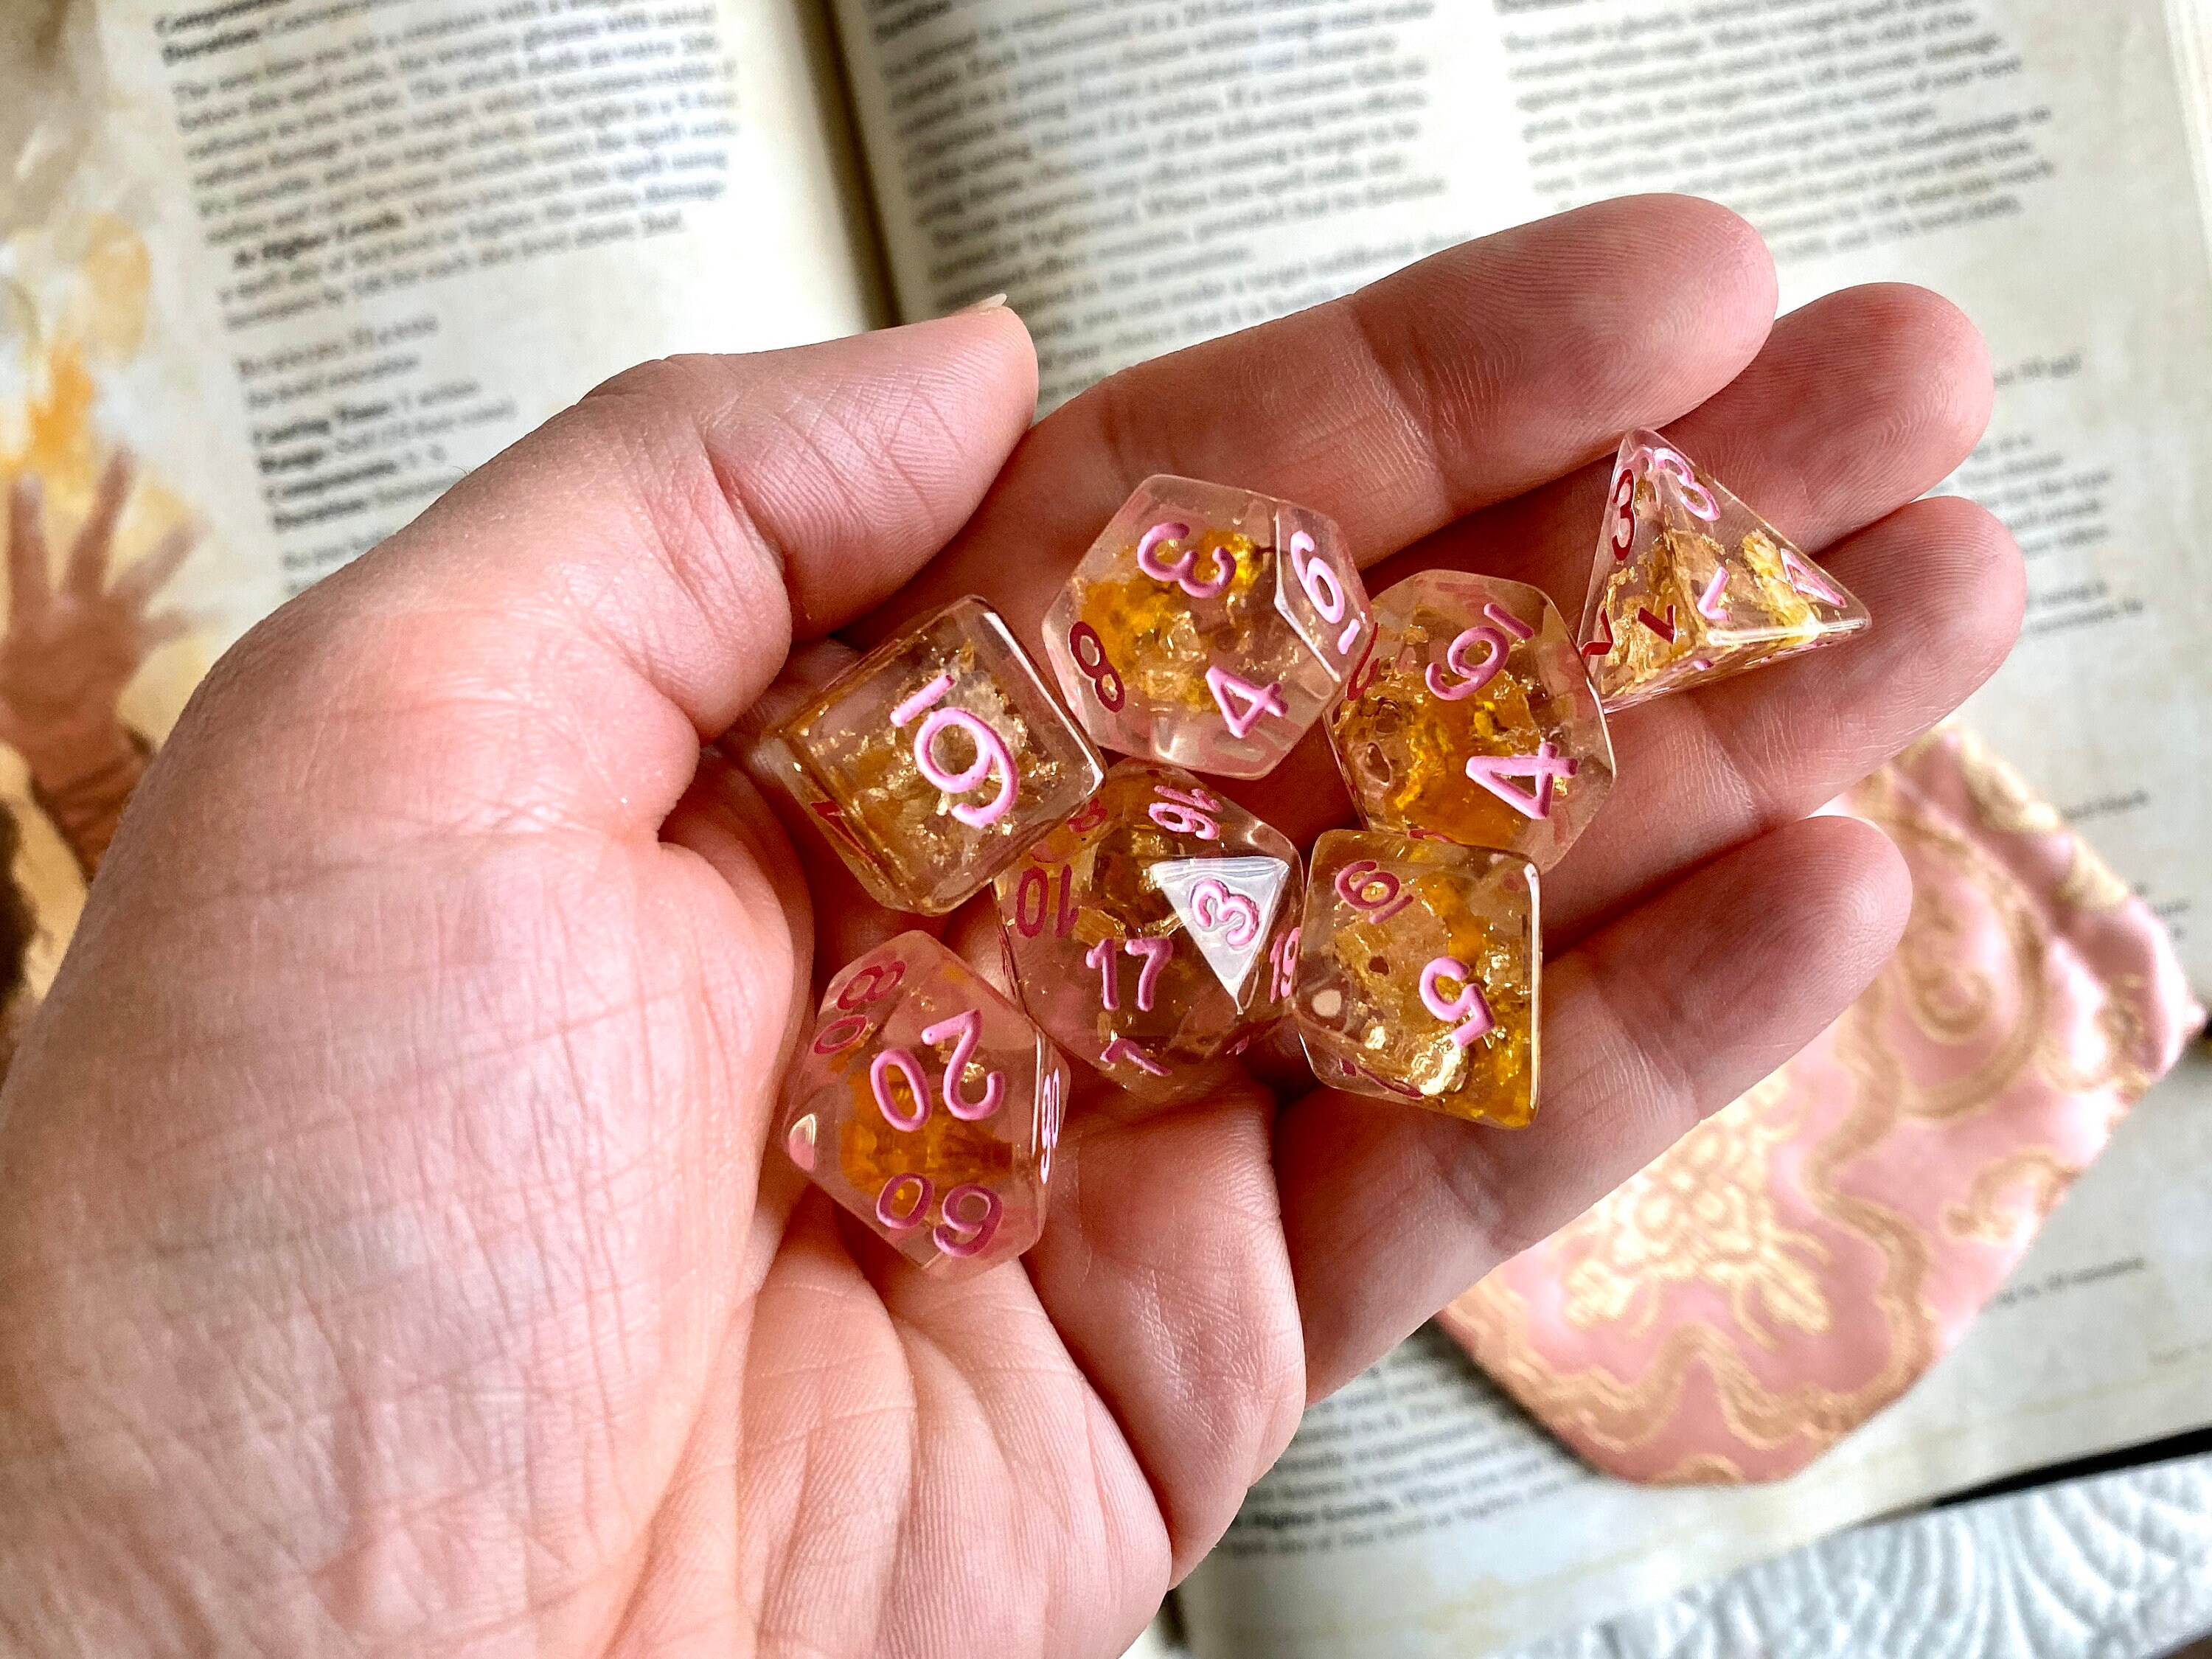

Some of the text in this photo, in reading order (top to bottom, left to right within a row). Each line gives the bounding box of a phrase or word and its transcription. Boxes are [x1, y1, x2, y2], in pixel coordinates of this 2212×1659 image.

[1612, 468, 1636, 561] 3
[1653, 447, 1721, 521] 3
[1136, 521, 1237, 599] 3
[1069, 621, 1125, 713] 8
[1205, 665, 1289, 738] 4
[1465, 741, 1579, 820] 4
[1190, 877, 1262, 947] 3
[1085, 937, 1174, 1012] 17
[1419, 956, 1496, 1048] 5
